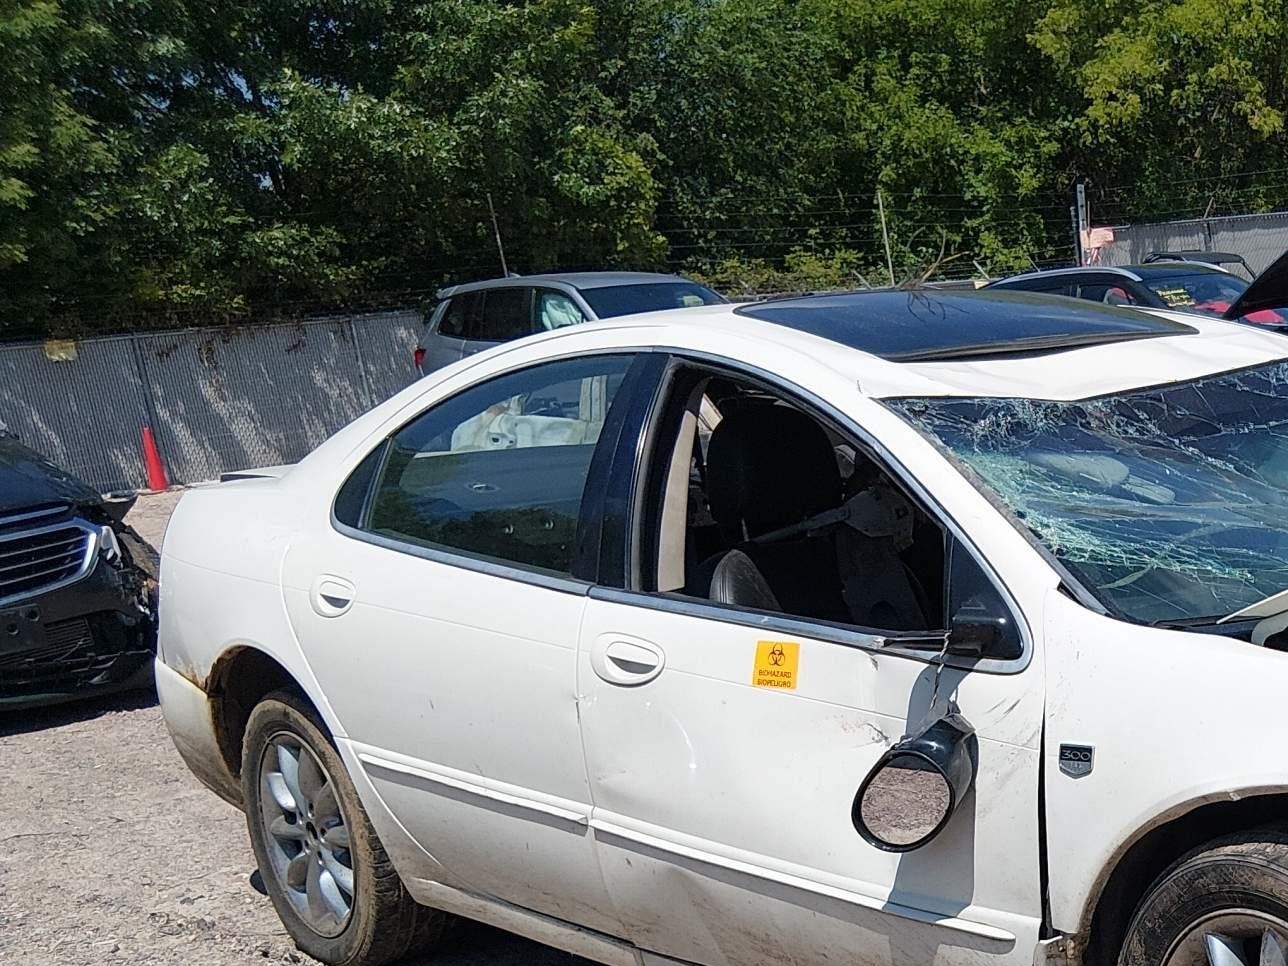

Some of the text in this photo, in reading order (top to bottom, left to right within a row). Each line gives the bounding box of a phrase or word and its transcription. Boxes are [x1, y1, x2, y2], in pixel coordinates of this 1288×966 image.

[758, 669, 792, 679] BIOHAZARD
[757, 678, 792, 688] BIOPELIGRO
[1061, 749, 1091, 761] 300
